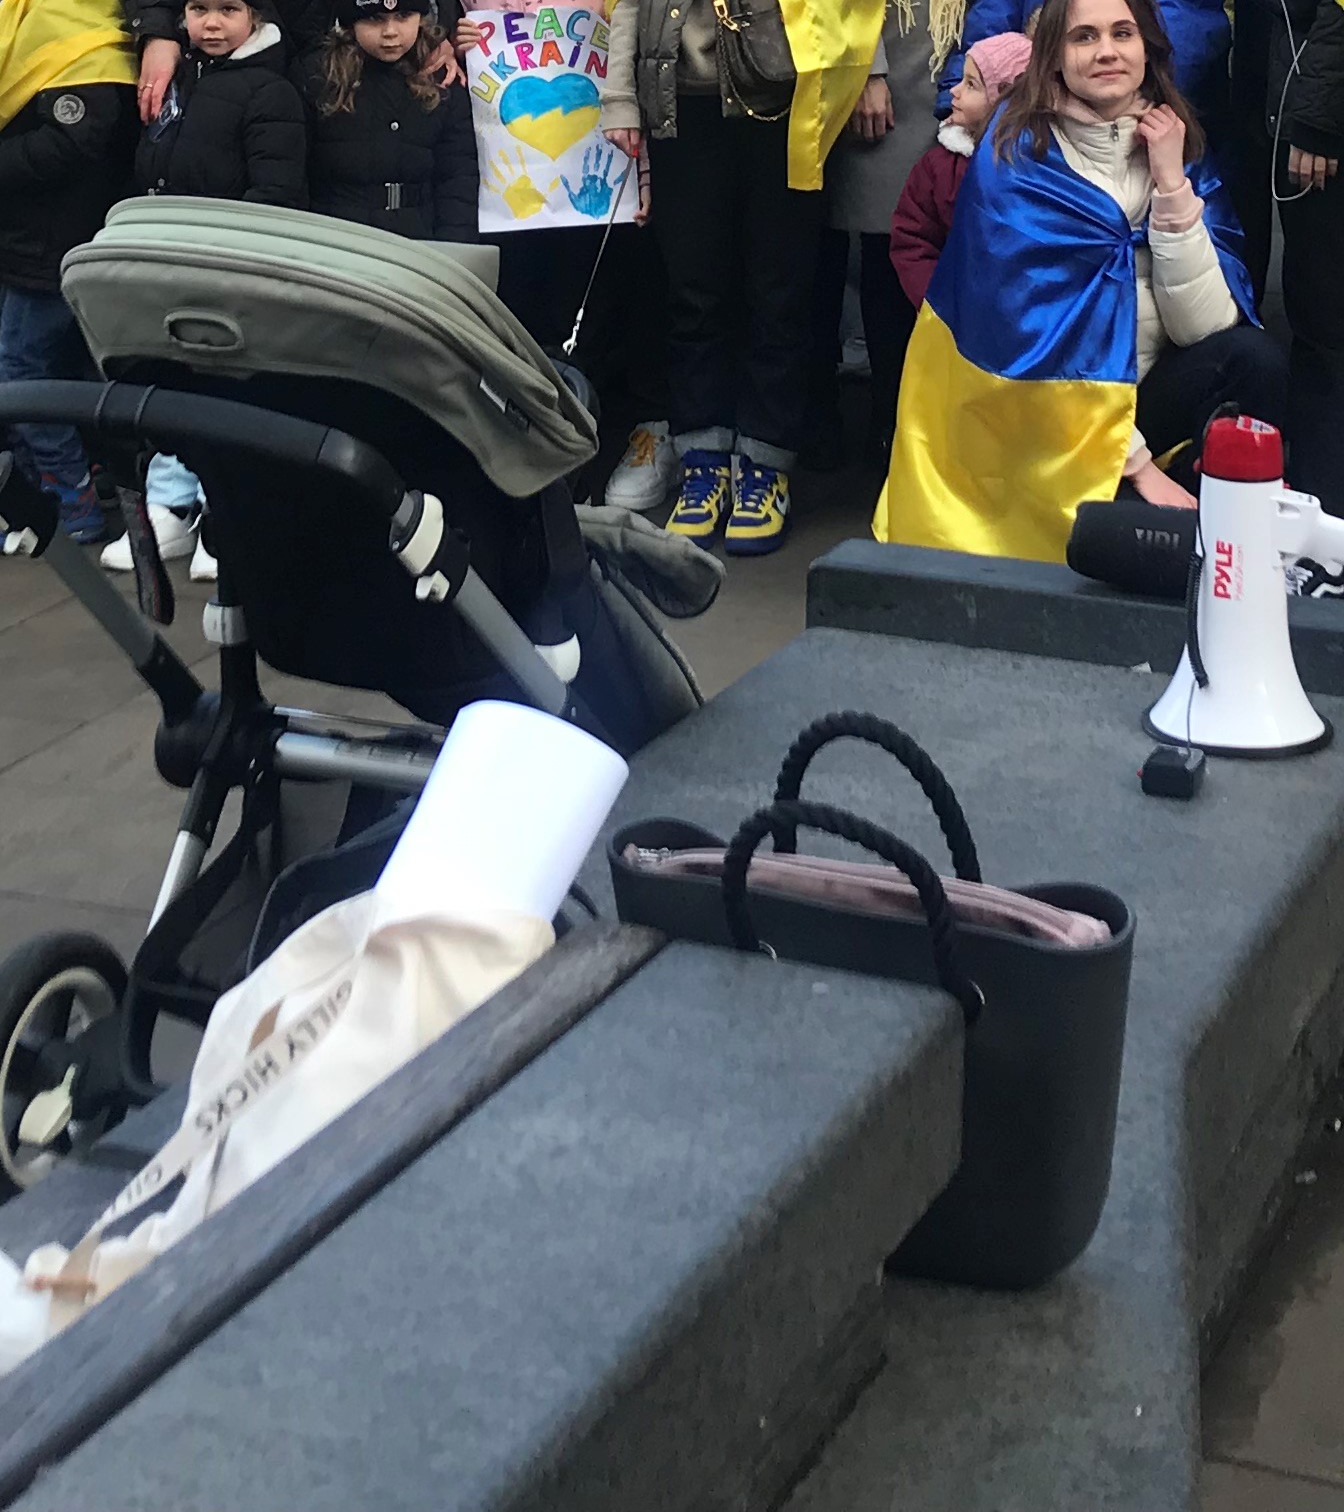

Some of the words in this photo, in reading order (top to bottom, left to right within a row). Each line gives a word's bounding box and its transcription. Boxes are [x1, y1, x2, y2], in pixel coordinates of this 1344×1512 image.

[476, 7, 610, 57] PEACE
[1214, 539, 1233, 599] PYLE
[285, 978, 354, 1062] GILLY
[195, 1049, 281, 1134] HICKS
